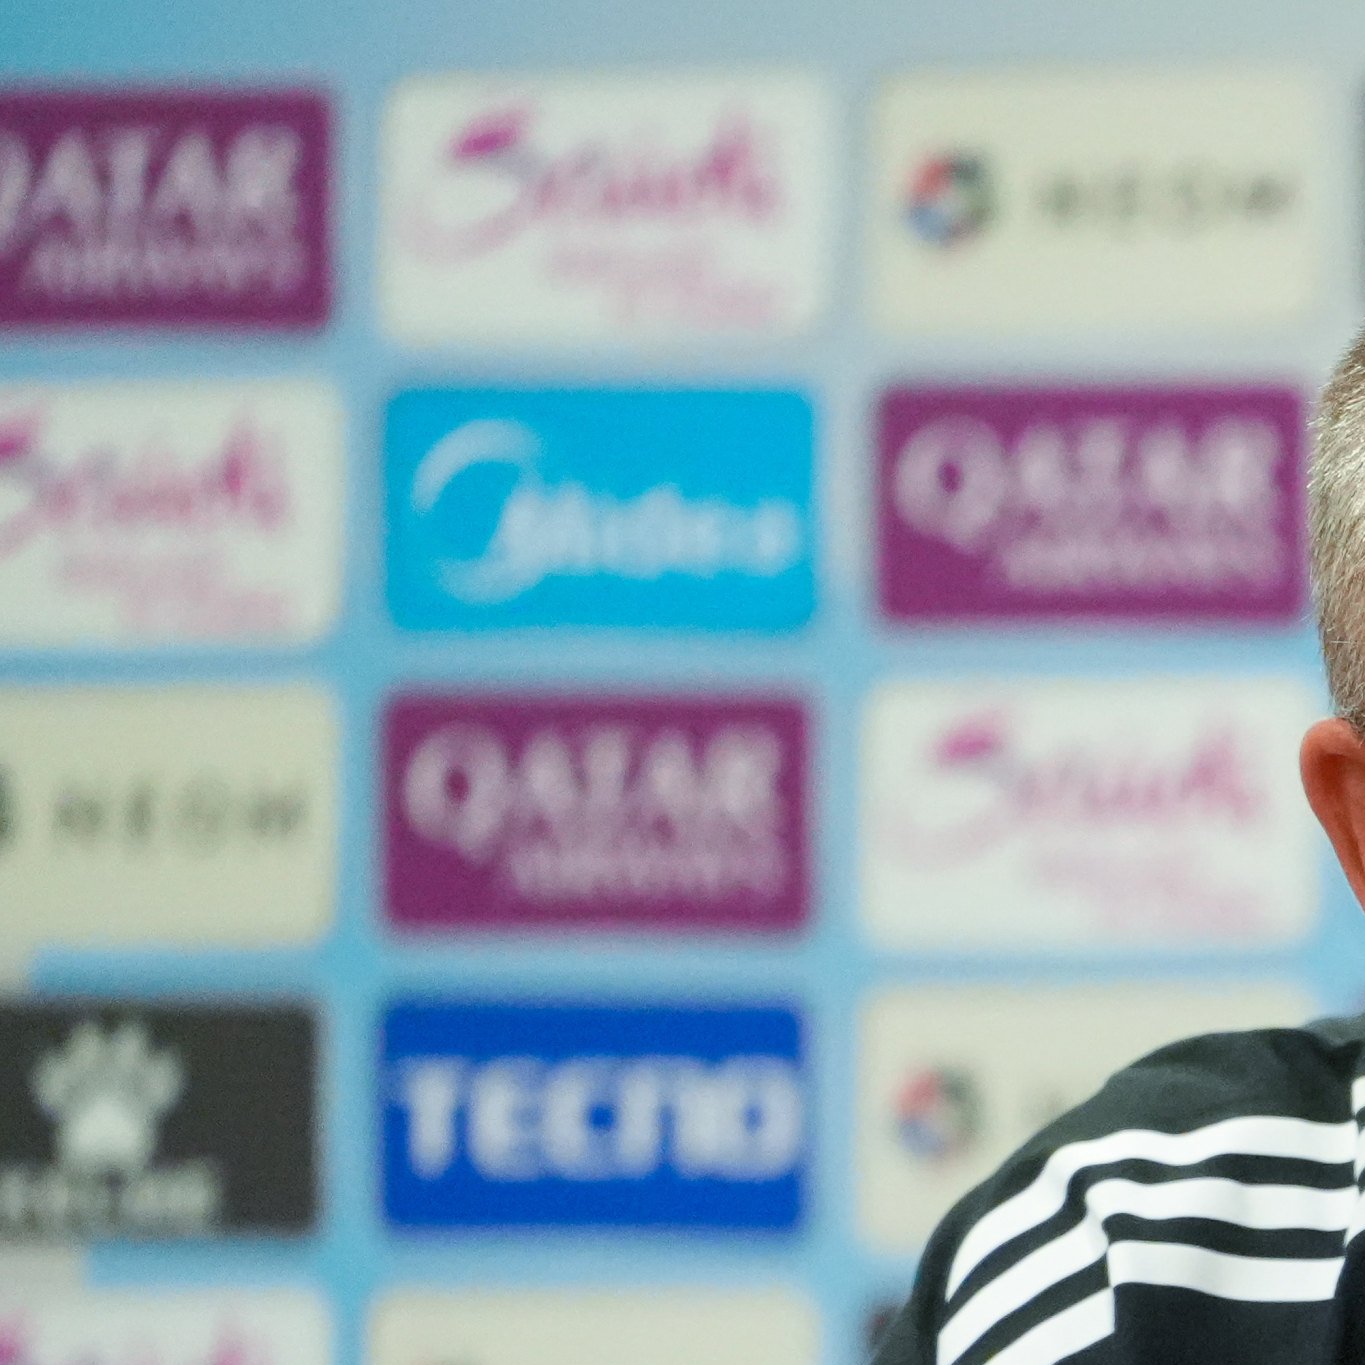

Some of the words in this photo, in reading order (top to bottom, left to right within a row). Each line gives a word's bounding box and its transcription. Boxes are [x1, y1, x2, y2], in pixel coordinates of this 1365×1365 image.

[893, 415, 1285, 552] QATAR
[405, 724, 785, 862] QATAR
[400, 1054, 802, 1180] TECNO
